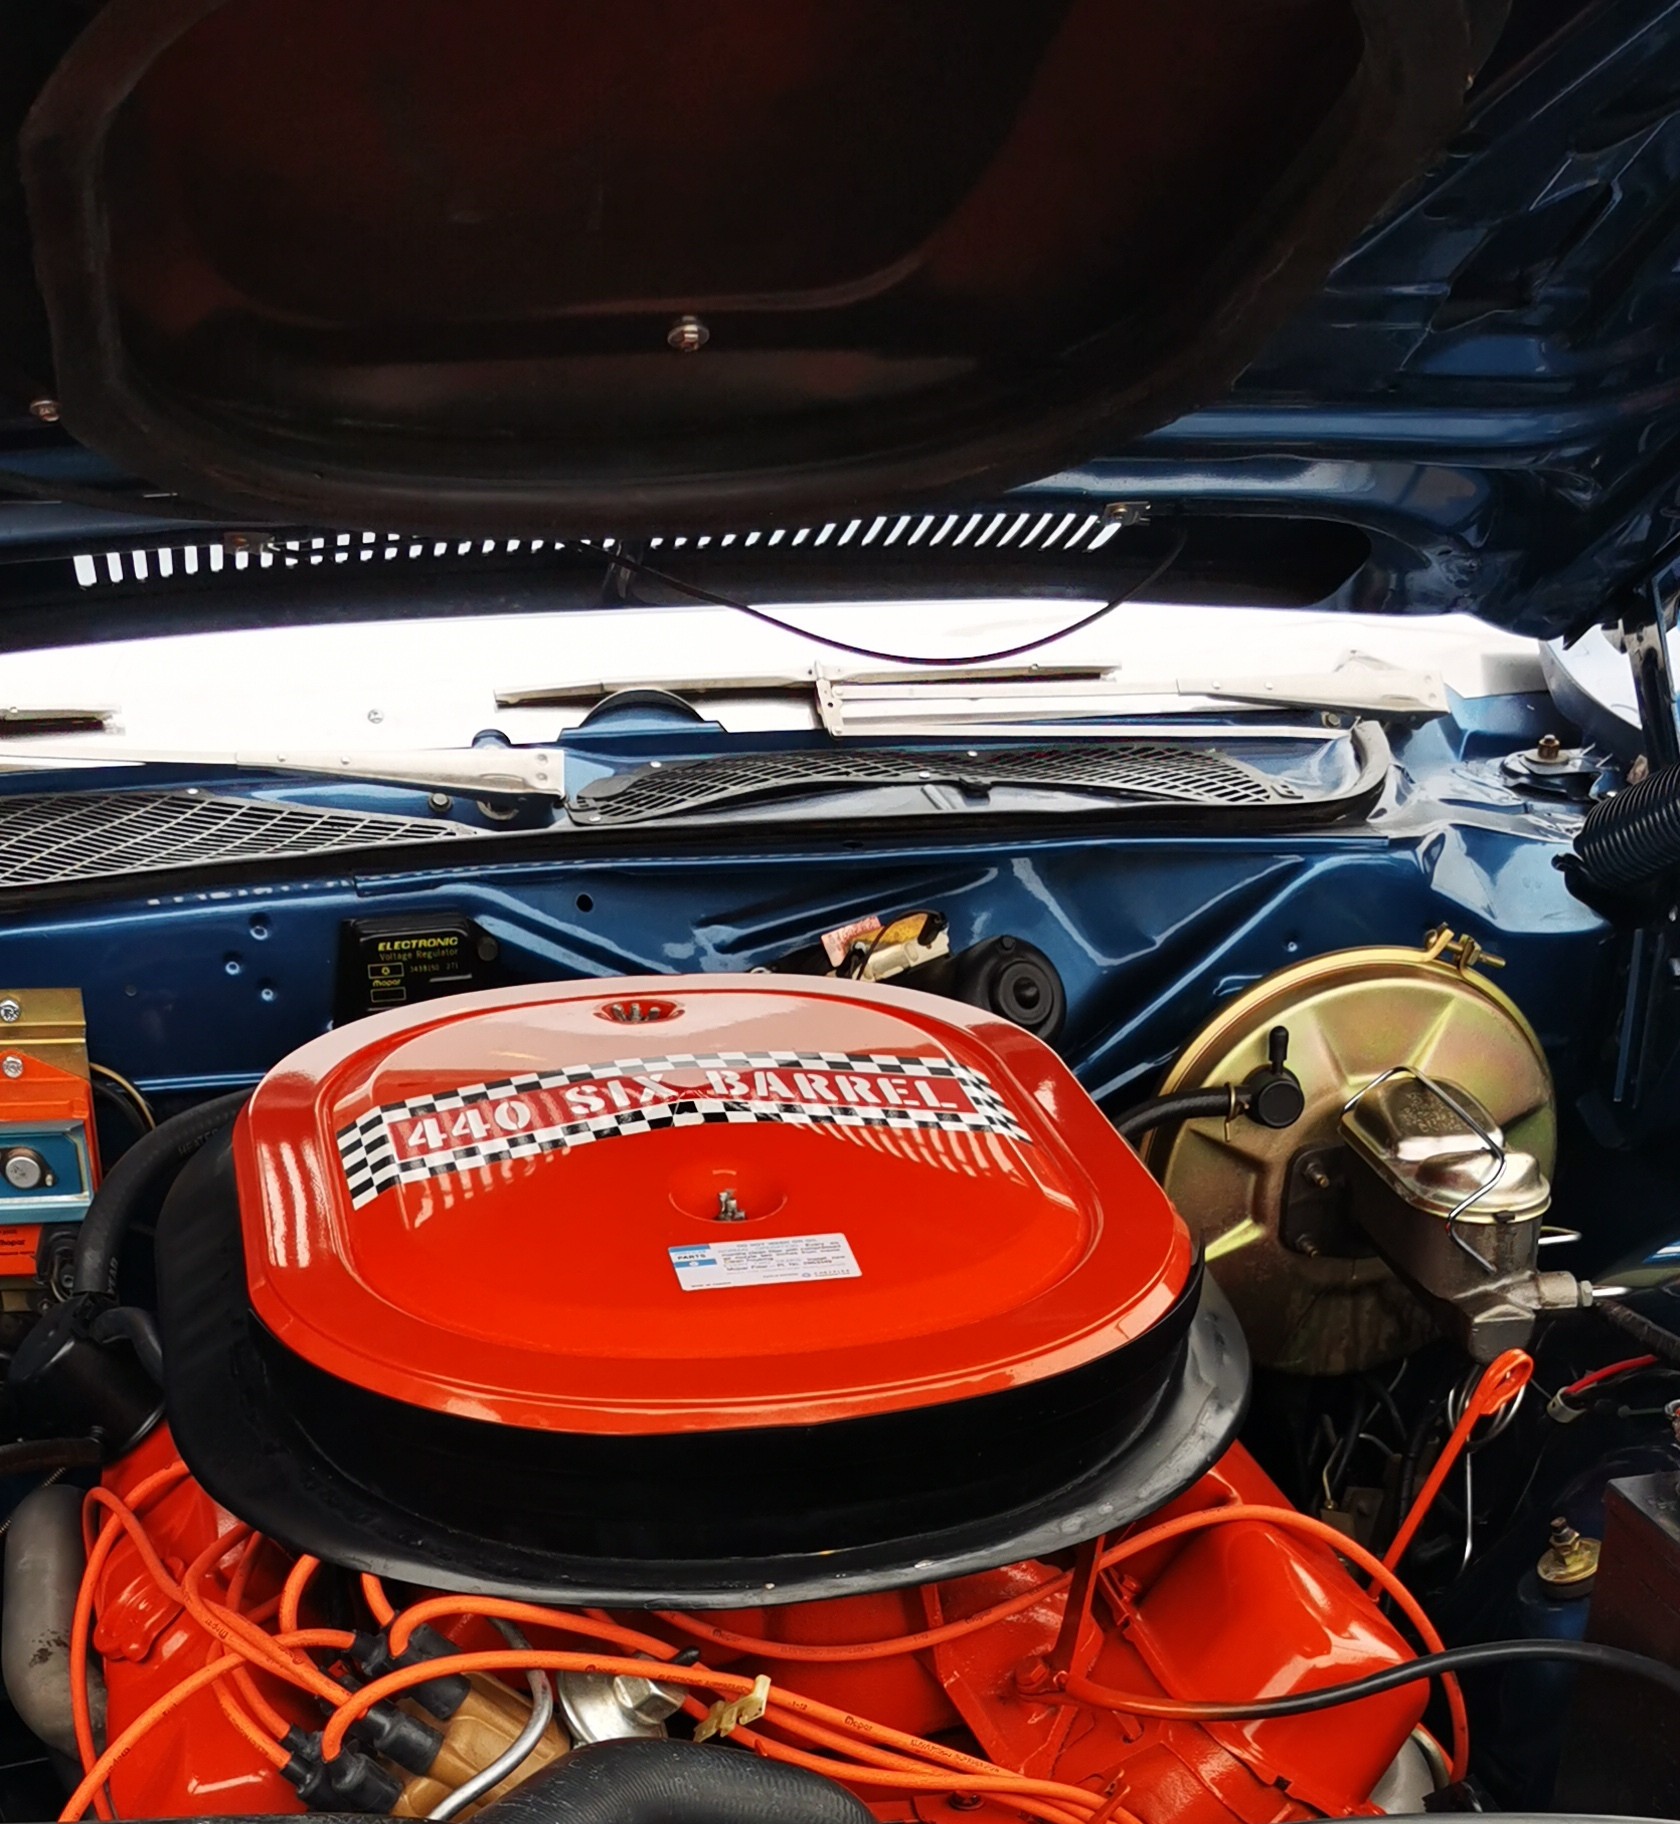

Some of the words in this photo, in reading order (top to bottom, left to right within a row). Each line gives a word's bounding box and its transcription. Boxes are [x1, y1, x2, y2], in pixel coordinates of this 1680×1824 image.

[378, 937, 459, 952] ELECTRONIC
[379, 951, 413, 962] Voltage
[416, 948, 459, 959] Regulator
[406, 1099, 531, 1150] 440
[568, 1071, 680, 1116] SIX
[706, 1067, 962, 1111] BARREL
[844, 1715, 873, 1732] Mopar
